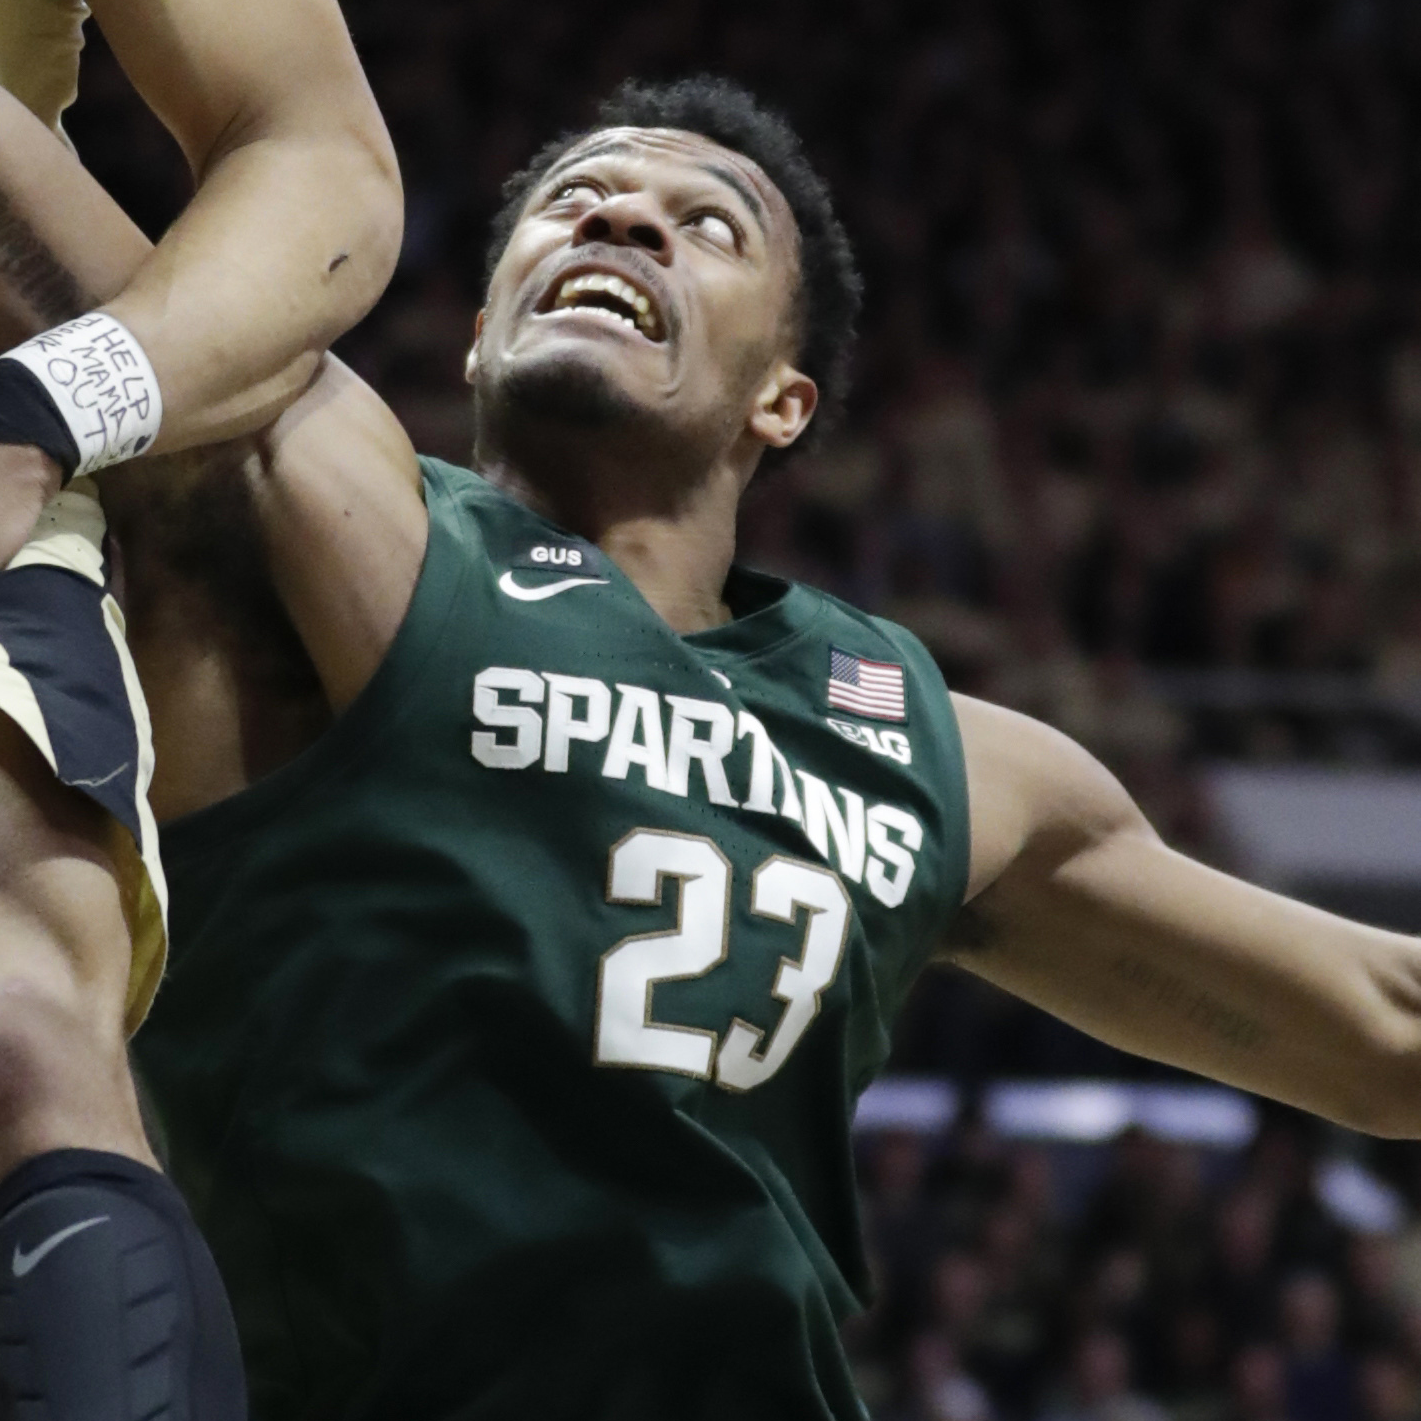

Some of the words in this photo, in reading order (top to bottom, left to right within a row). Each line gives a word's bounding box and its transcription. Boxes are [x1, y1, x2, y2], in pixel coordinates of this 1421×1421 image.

[47, 357, 108, 454] OUT
[71, 346, 128, 442] MAMA
[90, 327, 151, 421] HELP
[530, 545, 582, 567] GUS
[592, 826, 852, 1094] 23
